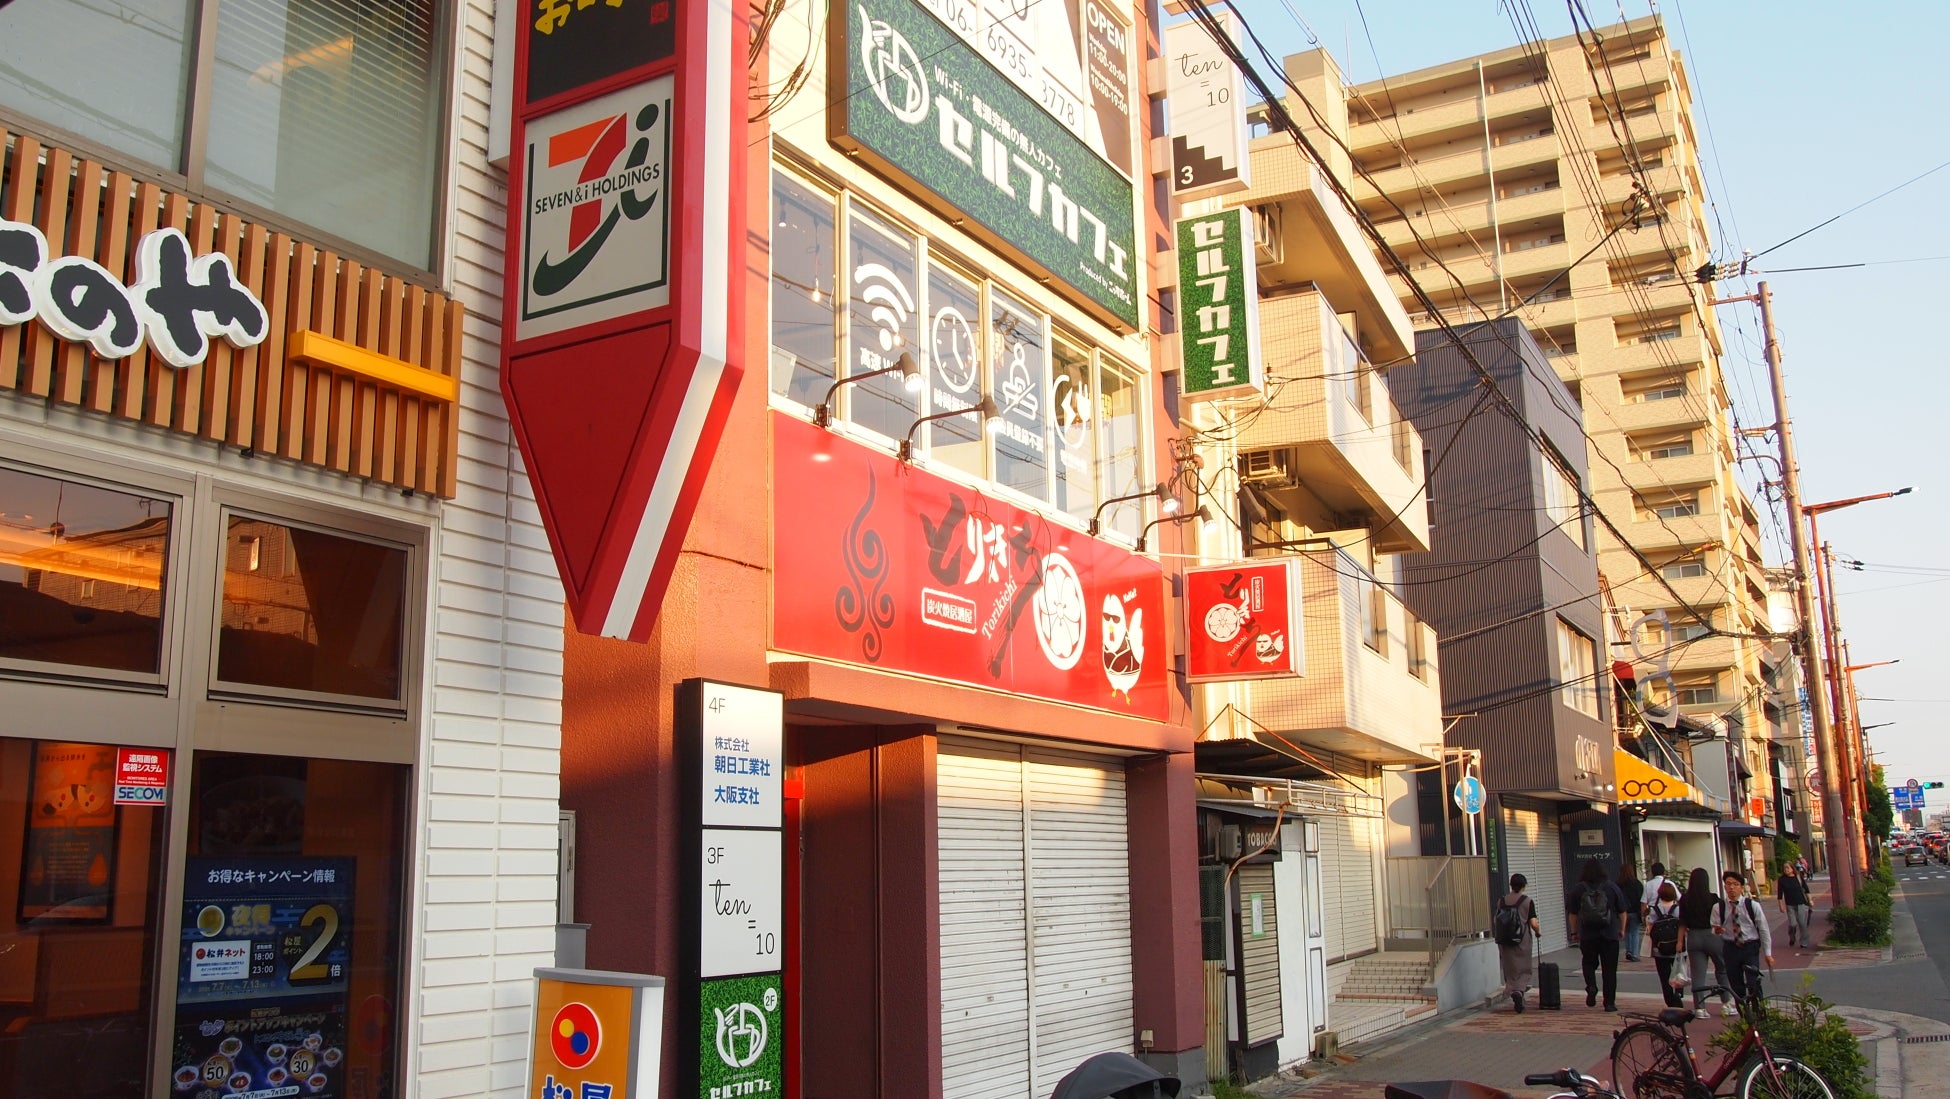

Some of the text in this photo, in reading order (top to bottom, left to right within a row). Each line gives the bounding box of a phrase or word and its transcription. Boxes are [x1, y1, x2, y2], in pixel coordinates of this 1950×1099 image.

[1087, 2, 1126, 55] OPEN
[1174, 53, 1224, 78] ten
[1091, 74, 1129, 115] 10:00-19:00
[1206, 87, 1230, 108] 10
[592, 162, 661, 198] HOLDINGS
[1181, 165, 1194, 185] 3
[935, 93, 1128, 282] セルフカフェ
[1190, 219, 1236, 385] セルフカフェ
[919, 492, 1043, 680] とりきち
[980, 575, 1019, 641] Torikichi
[1219, 572, 1262, 668] とりきち
[708, 696, 726, 714] 4F
[714, 736, 750, 753] 株式会社
[122, 762, 163, 773] 監視システム
[714, 754, 771, 777] 朝日工業社
[118, 786, 164, 800] SECOM
[714, 784, 760, 805] 大阪支社
[707, 846, 725, 864] 3F
[207, 869, 336, 884] お得なキャンペーン情報
[708, 878, 752, 916] ten
[289, 903, 339, 980] 2
[755, 932, 775, 956] 10
[254, 952, 274, 962] 18:00
[251, 965, 274, 975] 23:00
[330, 964, 342, 978] 倍
[765, 994, 775, 1007] 2F
[206, 1066, 224, 1081] 50
[293, 1060, 309, 1074] 30
[710, 1078, 772, 1099] セルフカフェ
